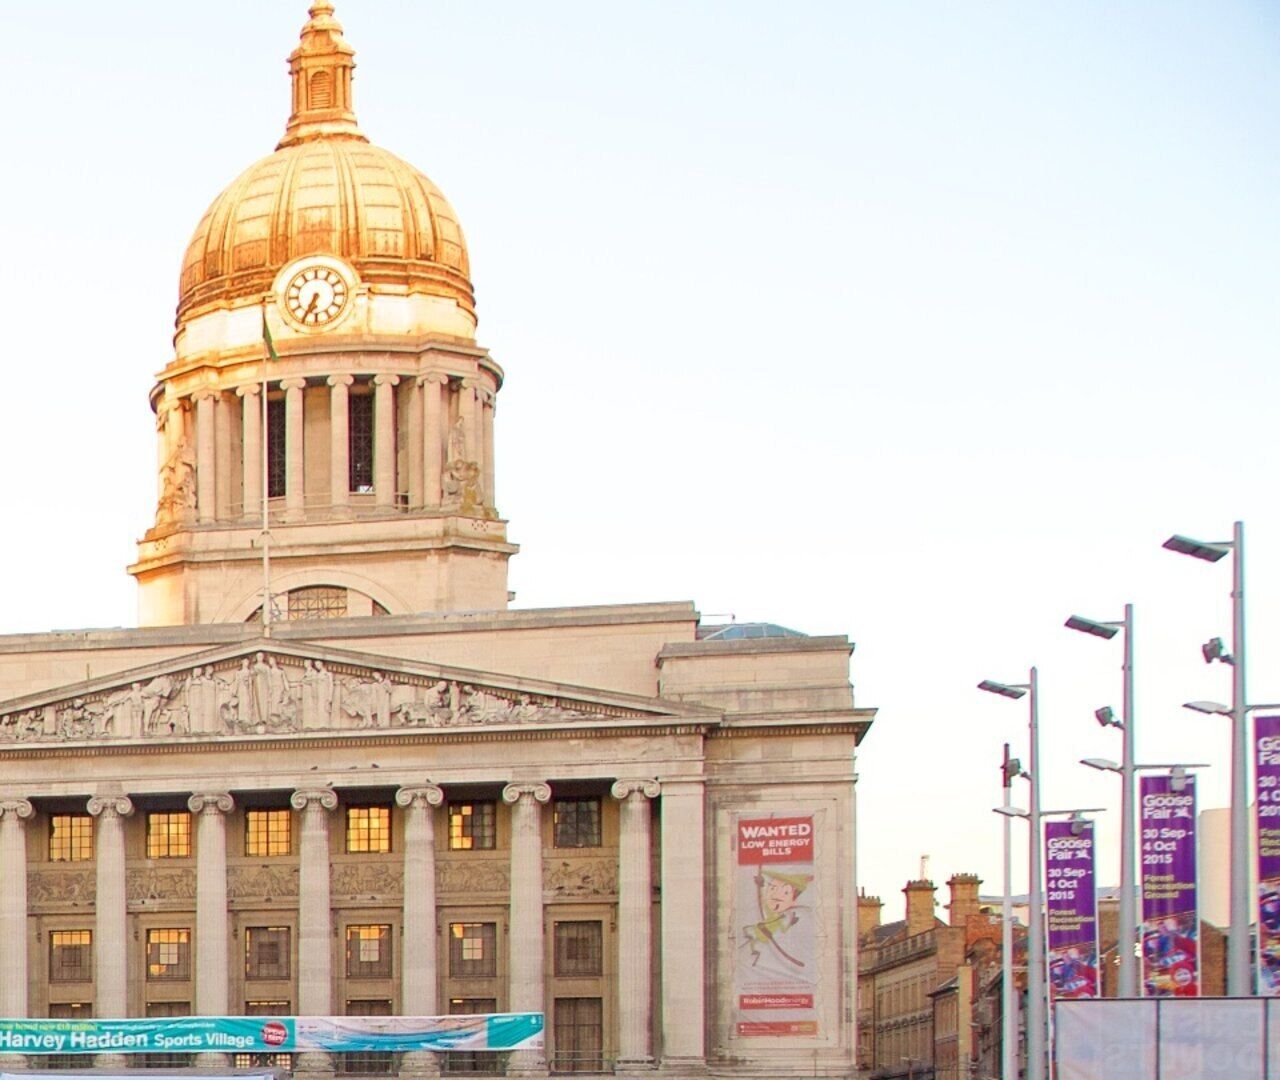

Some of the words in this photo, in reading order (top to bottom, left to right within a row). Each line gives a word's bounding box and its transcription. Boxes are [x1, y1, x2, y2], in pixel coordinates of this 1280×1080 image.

[1143, 795, 1192, 806] Goose
[1144, 808, 1172, 819] Fair
[741, 823, 811, 838] WANTED
[1143, 829, 1158, 839] 30
[1160, 828, 1185, 840] Sep
[742, 839, 765, 849] LOW
[769, 837, 810, 849] ENERGY
[1047, 838, 1092, 849] Goose
[1143, 841, 1151, 851] 4
[1153, 841, 1176, 851] Oct
[762, 847, 792, 857] BILLS
[1048, 850, 1072, 861] Fair
[1144, 854, 1173, 864] 2015
[1048, 869, 1062, 878] 30
[1063, 868, 1085, 880] Sep
[1048, 880, 1056, 889] 4
[1057, 880, 1077, 889] Oct
[1049, 891, 1075, 900] 2015
[0, 1031, 64, 1050] Harvey
[70, 1029, 148, 1048] Hadden
[154, 1033, 202, 1048] Sports
[205, 1032, 254, 1048] Village
